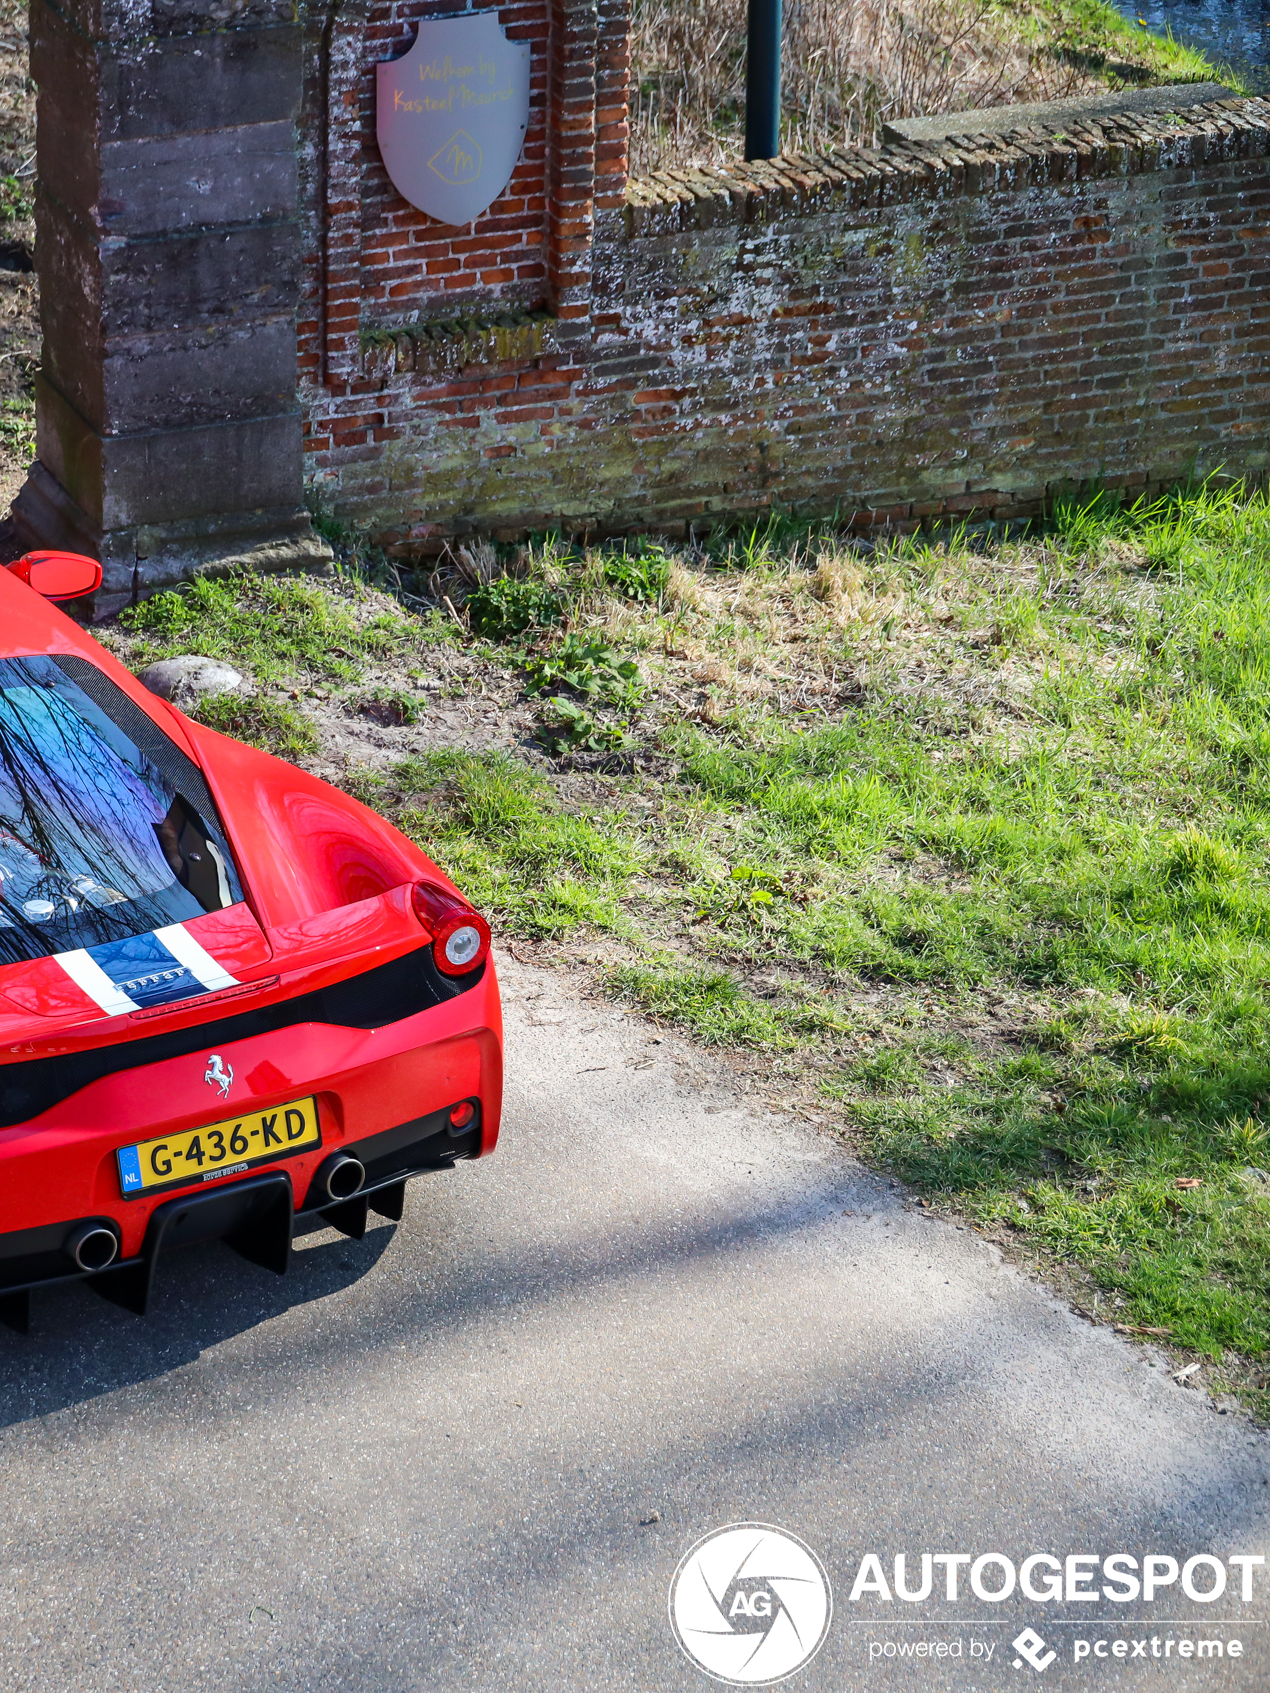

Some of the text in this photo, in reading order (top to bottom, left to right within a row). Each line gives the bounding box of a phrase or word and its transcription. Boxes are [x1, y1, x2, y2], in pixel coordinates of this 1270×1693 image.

[419, 56, 475, 83] Welkom
[394, 86, 454, 113] Kasteel
[125, 1108, 306, 1184] NL G-436-KD
